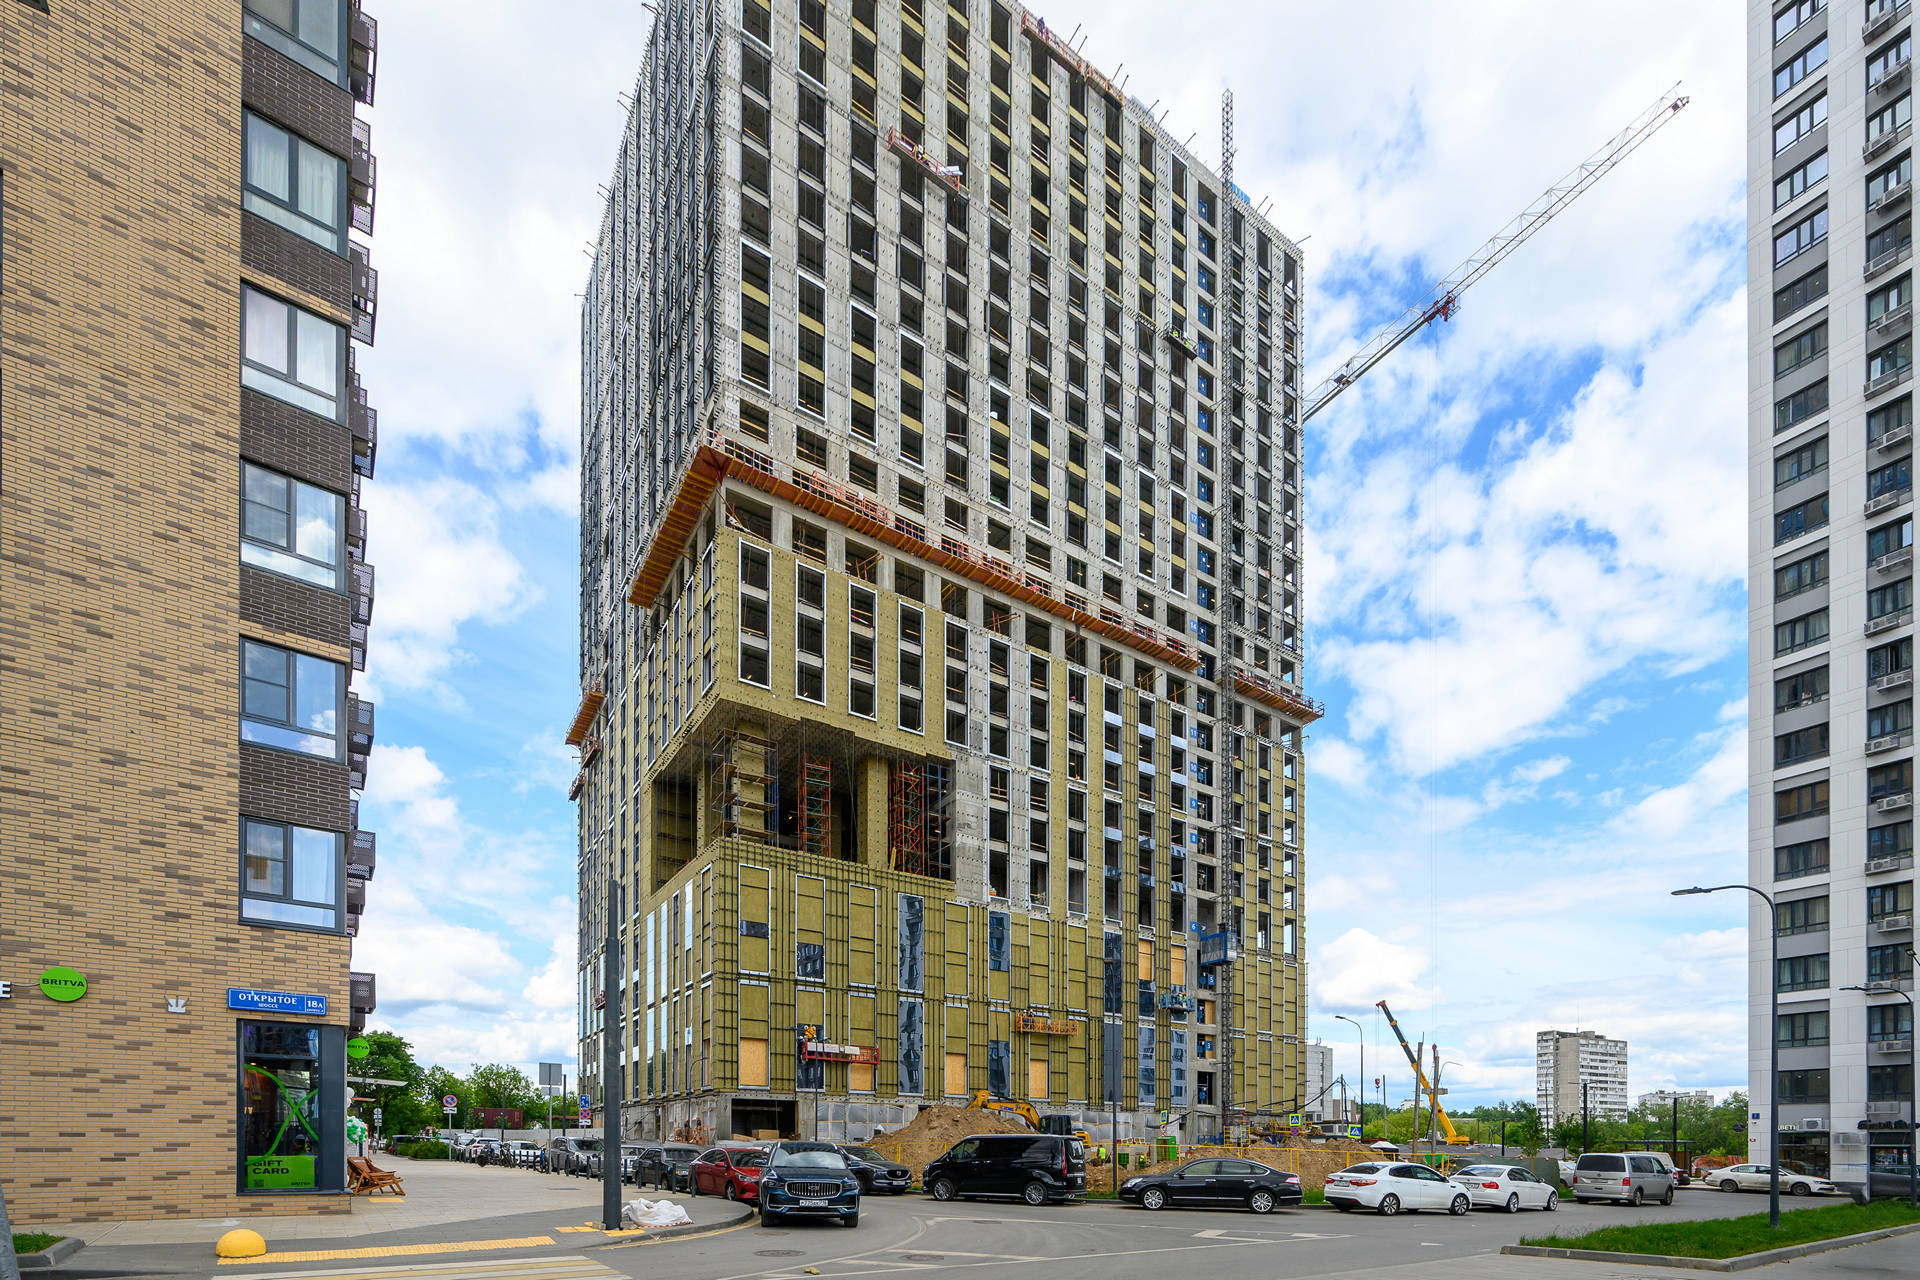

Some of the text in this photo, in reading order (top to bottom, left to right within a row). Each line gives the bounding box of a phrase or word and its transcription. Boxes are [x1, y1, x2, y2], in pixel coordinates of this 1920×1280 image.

[42, 978, 85, 987] BRITVA
[238, 993, 297, 1005] ОТКРЫТОЕ
[252, 1167, 290, 1175] CARD
